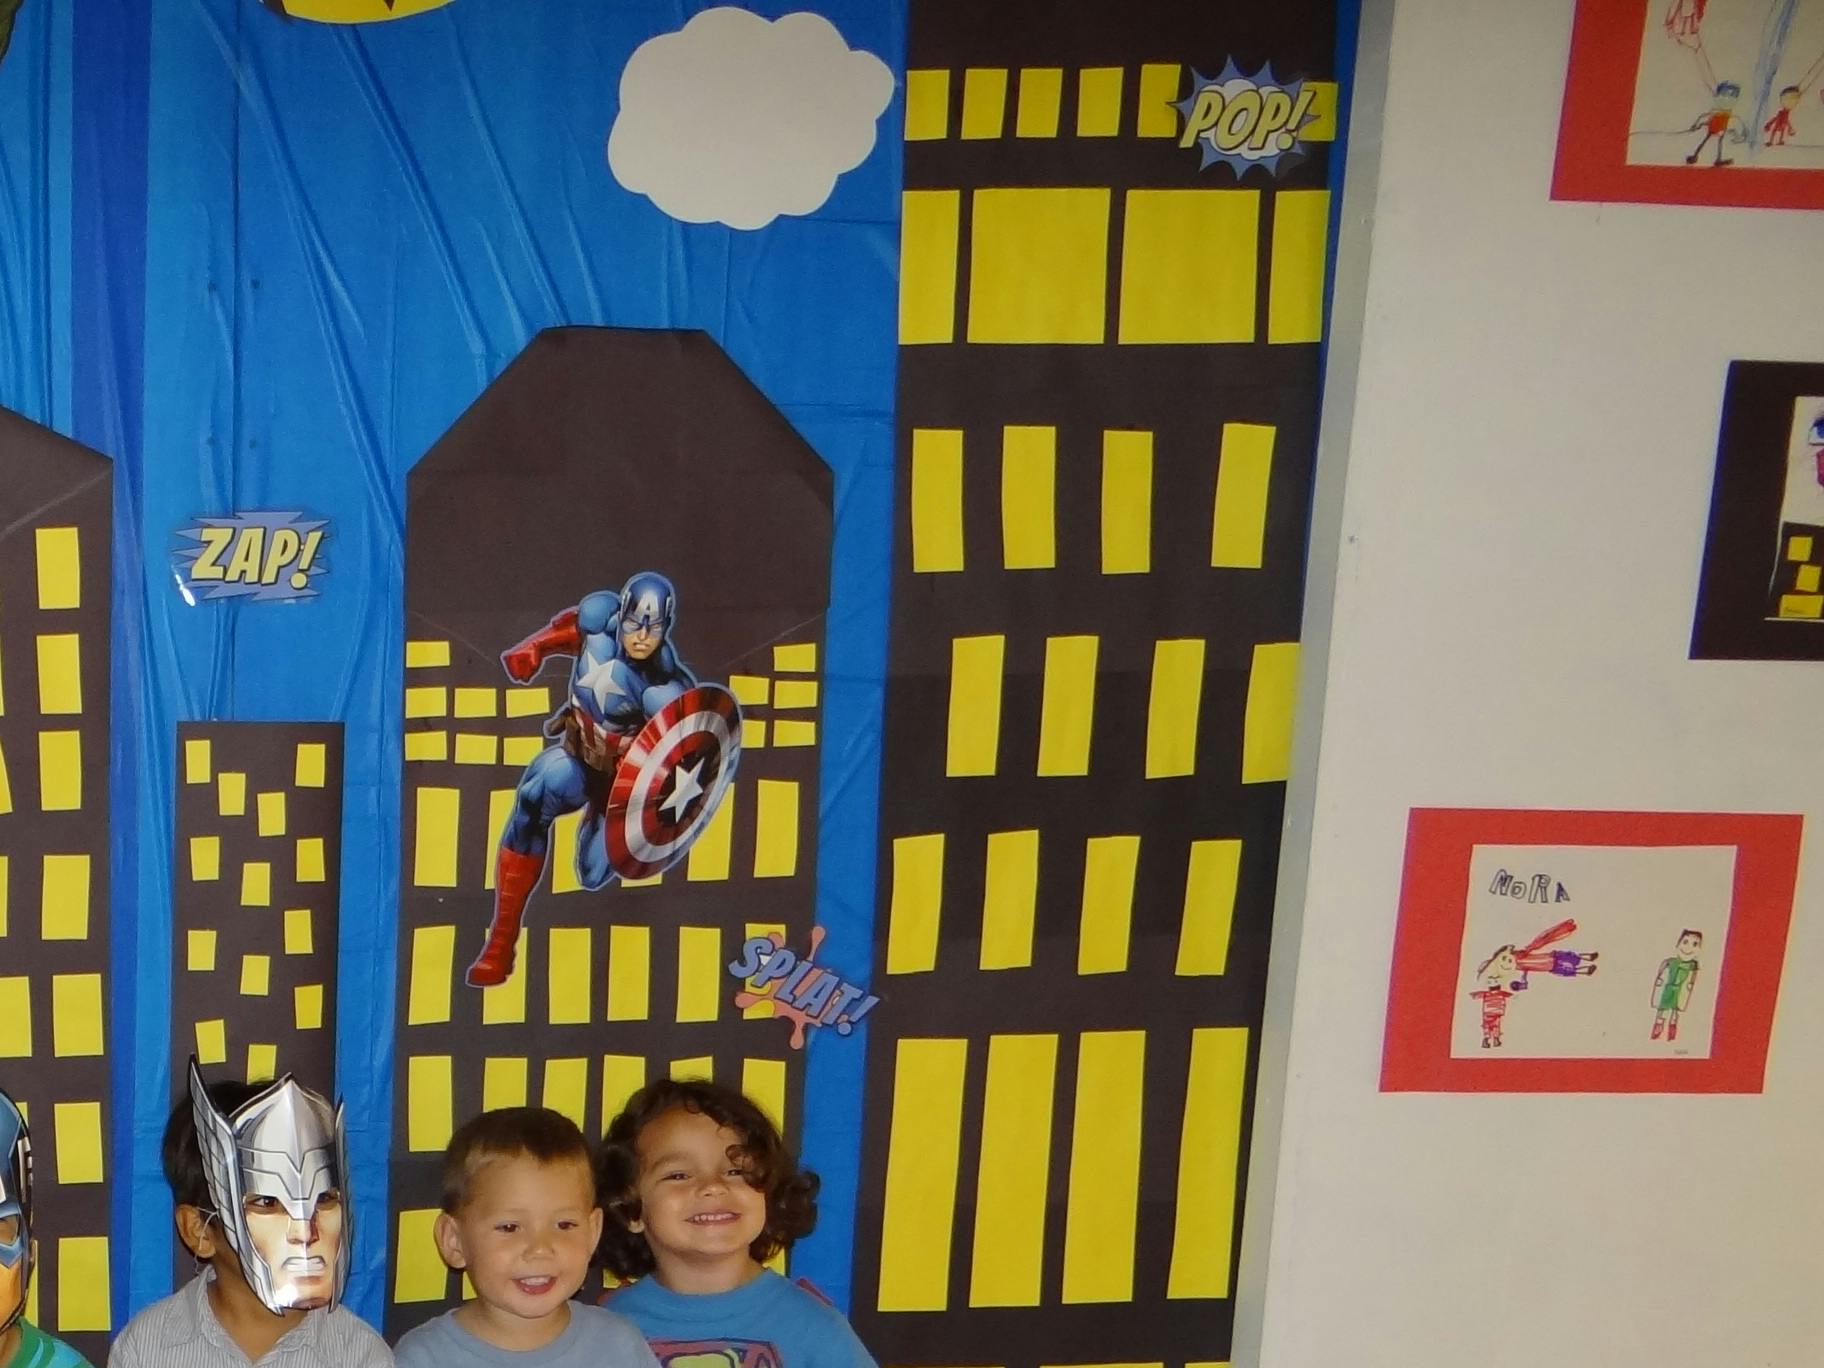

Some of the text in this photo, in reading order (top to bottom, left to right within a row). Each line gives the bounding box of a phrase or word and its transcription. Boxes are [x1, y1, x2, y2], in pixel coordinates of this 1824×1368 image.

[1178, 88, 1317, 151] POP!
[190, 525, 325, 590] ZAP!
[728, 936, 880, 1036] SPLAT!
